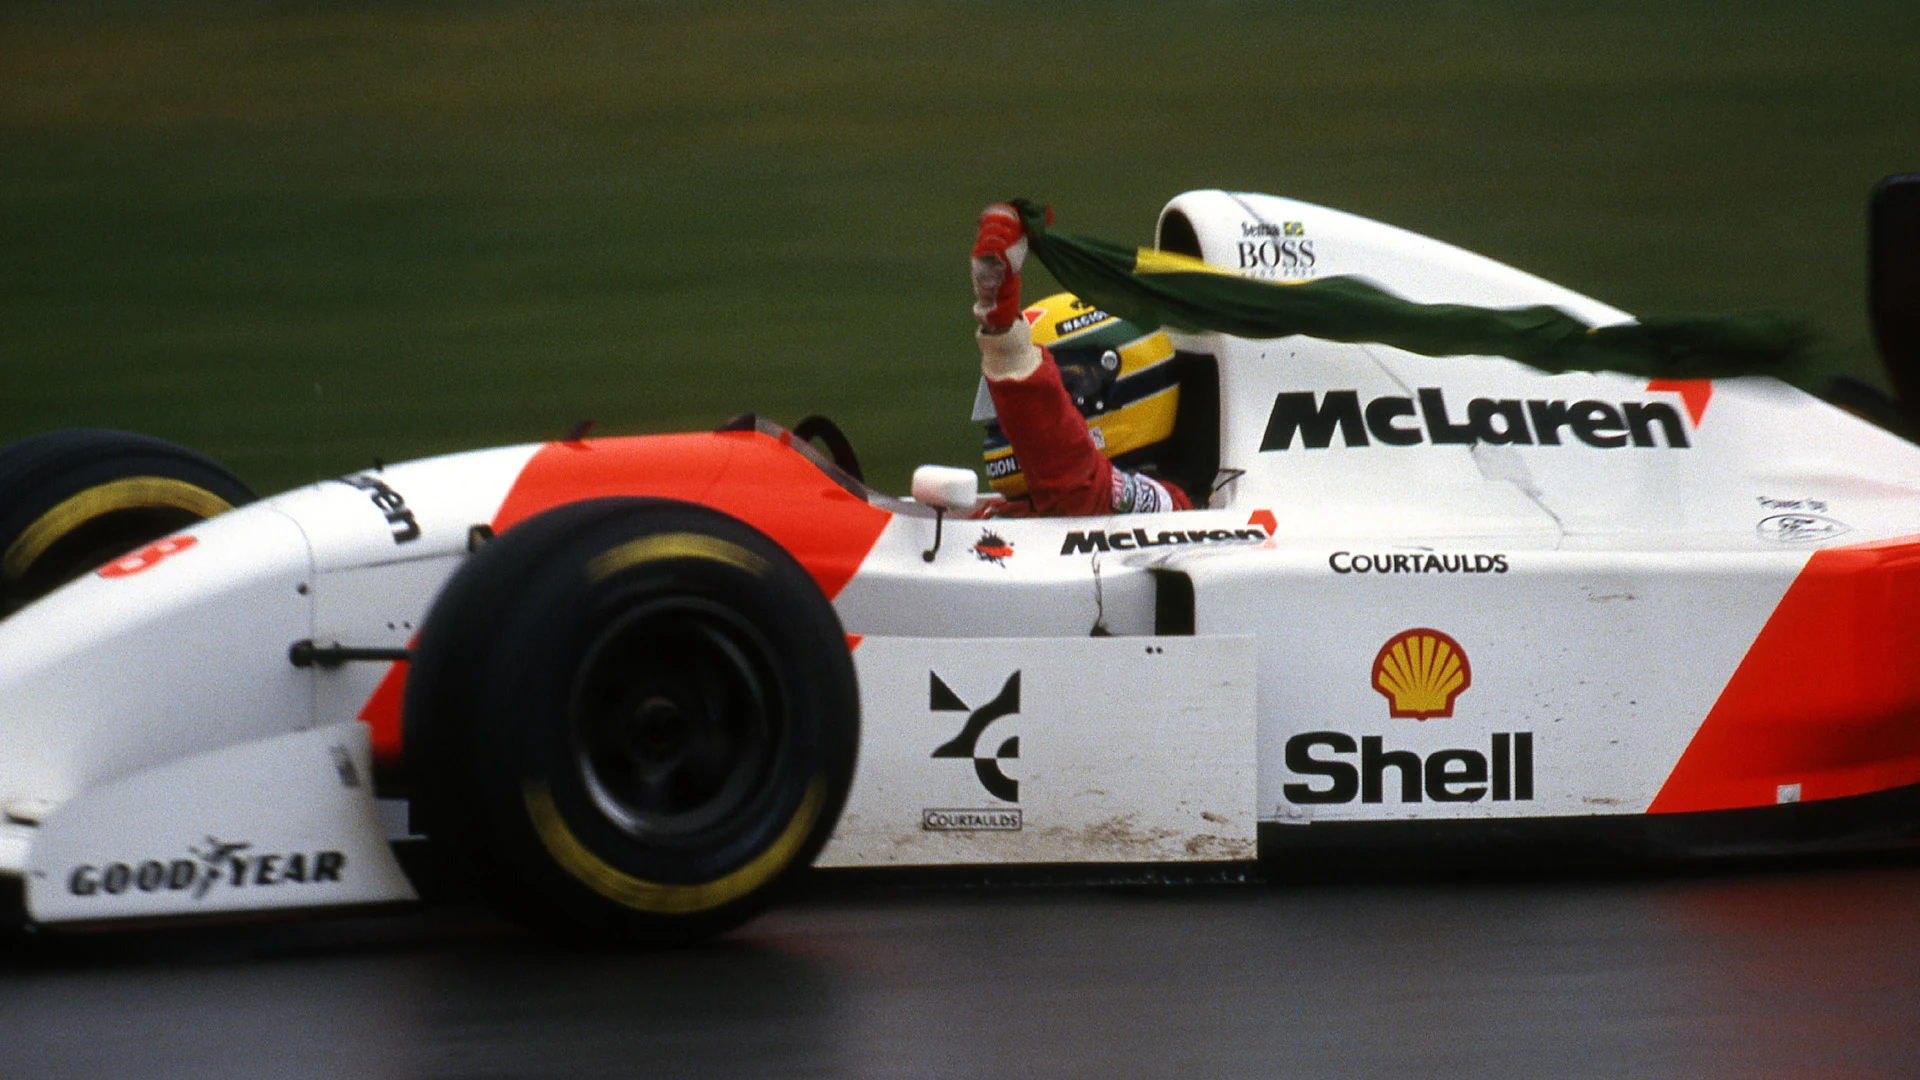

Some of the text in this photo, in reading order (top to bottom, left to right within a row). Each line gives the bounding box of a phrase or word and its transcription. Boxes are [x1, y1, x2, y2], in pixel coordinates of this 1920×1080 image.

[1239, 240, 1316, 269] BOSS
[1259, 387, 1692, 453] McLaren
[1060, 528, 1265, 556] McLaren
[1329, 551, 1509, 574] COURTAULDS
[1283, 730, 1534, 804] Shell
[927, 811, 1018, 828] COURTAULDS
